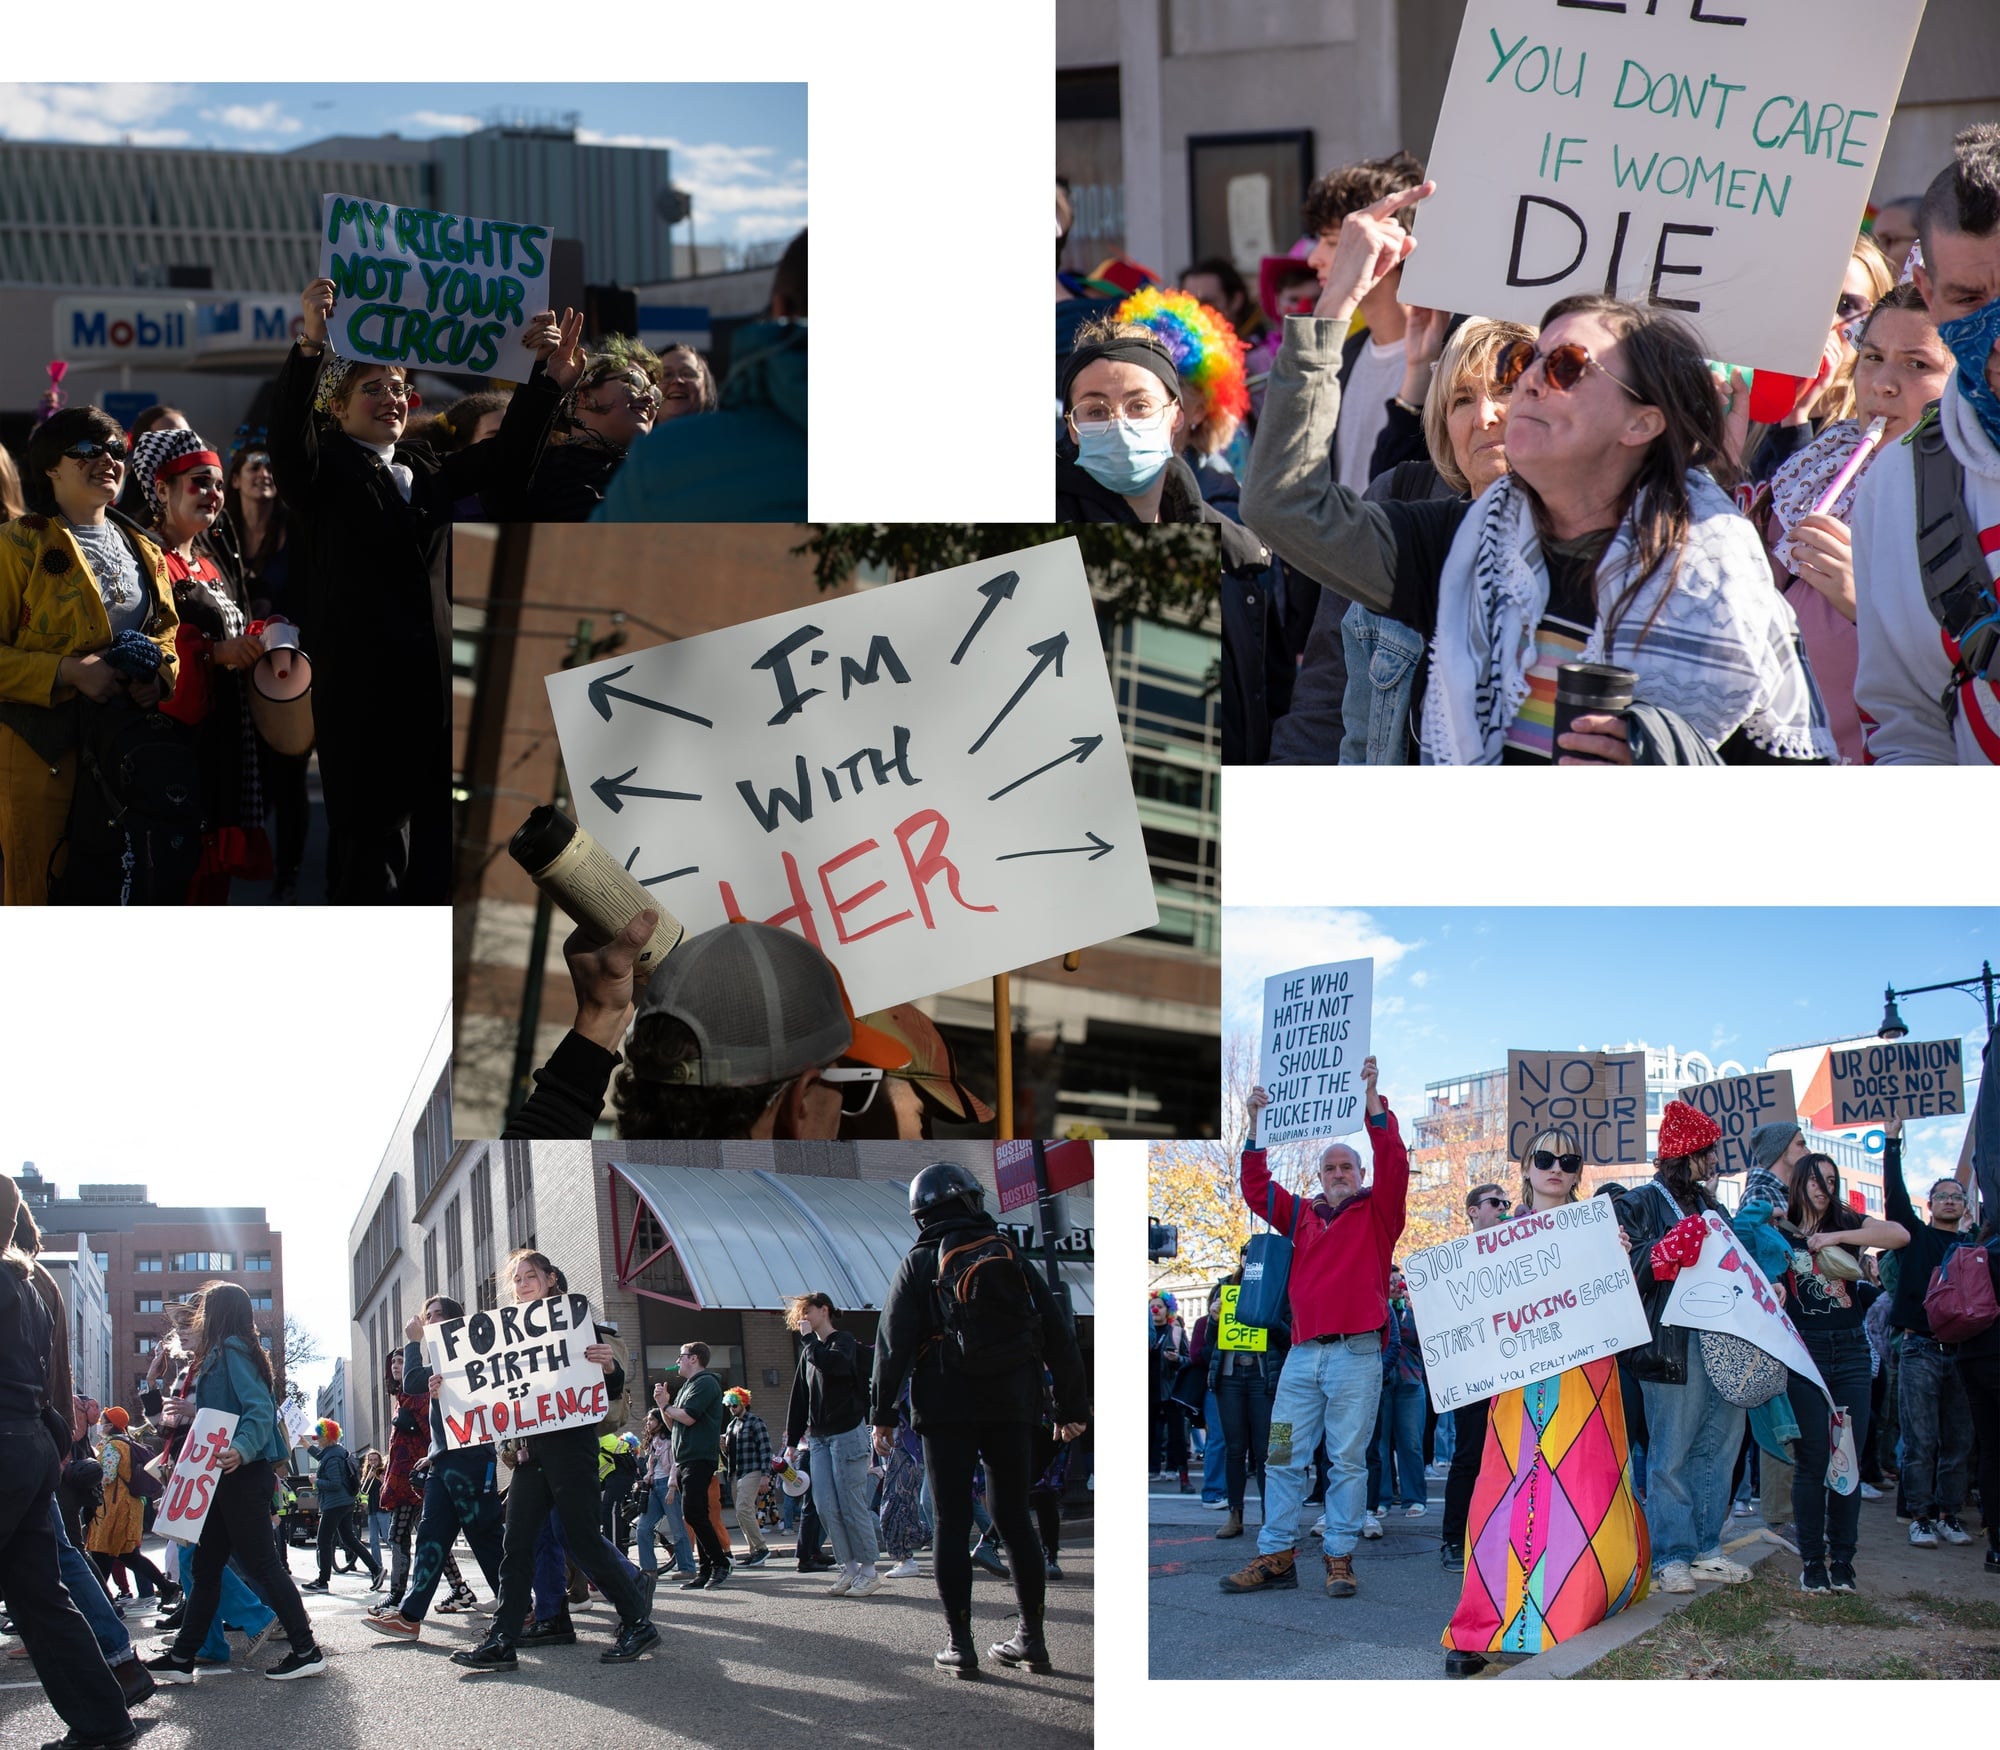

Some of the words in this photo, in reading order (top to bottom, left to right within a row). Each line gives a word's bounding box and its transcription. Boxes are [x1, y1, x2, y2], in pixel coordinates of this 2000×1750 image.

[1486, 27, 1587, 98] YOU
[1613, 60, 1747, 130] DON'T
[1752, 96, 1879, 168] CARE
[1539, 132, 1588, 182] IF
[1613, 144, 1792, 218] WOMEN
[328, 197, 390, 250] MY
[394, 207, 548, 278] RIGHTS
[1506, 194, 1715, 314] DIE
[331, 252, 412, 303] NOT
[419, 262, 525, 327] YOUR
[72, 311, 184, 347] Mobil
[347, 303, 506, 373] CIRCUS
[735, 725, 923, 832] WITH
[718, 808, 1000, 949] HER
[1283, 978, 1305, 1002] HE
[1311, 971, 1349, 996] WHO
[1273, 1000, 1314, 1029] HATH
[1318, 994, 1353, 1019] NOT
[1272, 1032, 1281, 1054] A
[1285, 1020, 1350, 1051] UTERUS
[1830, 1050, 1862, 1080] UR
[1868, 1040, 1961, 1075] OPINION
[1278, 1045, 1343, 1077] SHOULD
[1518, 1060, 1636, 1095] NOT
[1853, 1075, 1899, 1098] DOES
[1906, 1070, 1947, 1092] NOT
[1267, 1075, 1312, 1105] SHUT
[1317, 1071, 1352, 1095] THE
[1519, 1097, 1637, 1119] YOUR
[1842, 1091, 1957, 1123] MATTER
[1264, 1098, 1334, 1131] FUCKETH
[1337, 1096, 1357, 1119] UP
[1268, 1127, 1309, 1143] FALLOPIANS
[1312, 1125, 1332, 1137] 19:73
[1405, 1239, 1468, 1291] STOP
[1476, 1214, 1554, 1254] FUCKING
[1556, 1200, 1609, 1230] OVER
[1446, 1243, 1561, 1311] WOMEN
[440, 1294, 589, 1361] FORCED
[1423, 1318, 1485, 1367] START
[1492, 1289, 1577, 1336] FUCKING
[1579, 1268, 1630, 1306] EACH
[1500, 1321, 1563, 1358] OTHER
[465, 1340, 571, 1394] BIRTH
[1436, 1386, 1460, 1409] WE
[1465, 1376, 1495, 1395] KNOW
[1500, 1370, 1525, 1384] YOU
[1529, 1355, 1566, 1374] REALLY
[1568, 1344, 1595, 1362] WANT
[1603, 1337, 1619, 1348] TO
[445, 1381, 608, 1446] VIOLENCE
[508, 1383, 531, 1400] IS
